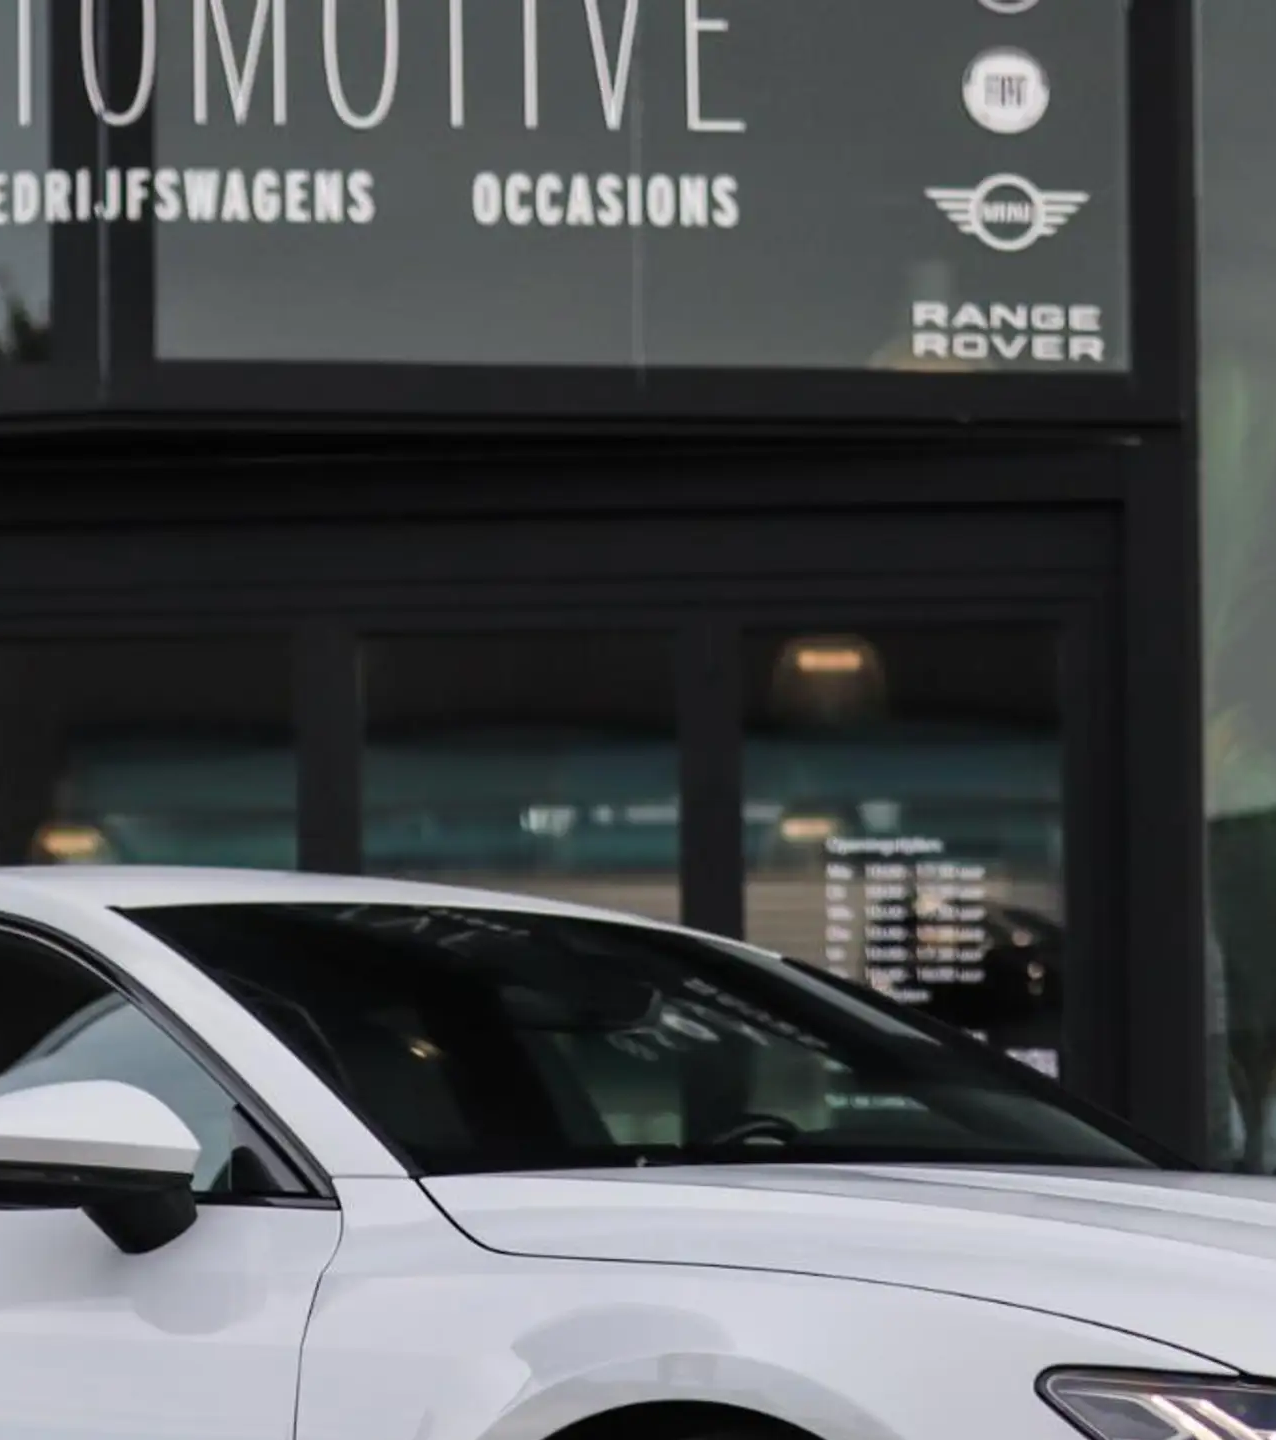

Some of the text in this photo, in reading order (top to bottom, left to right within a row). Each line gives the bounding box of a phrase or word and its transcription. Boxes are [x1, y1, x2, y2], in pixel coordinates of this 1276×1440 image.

[471, 171, 740, 228] OCCASIONS
[911, 301, 1103, 331] RANGE
[911, 332, 1106, 362] ROVER
